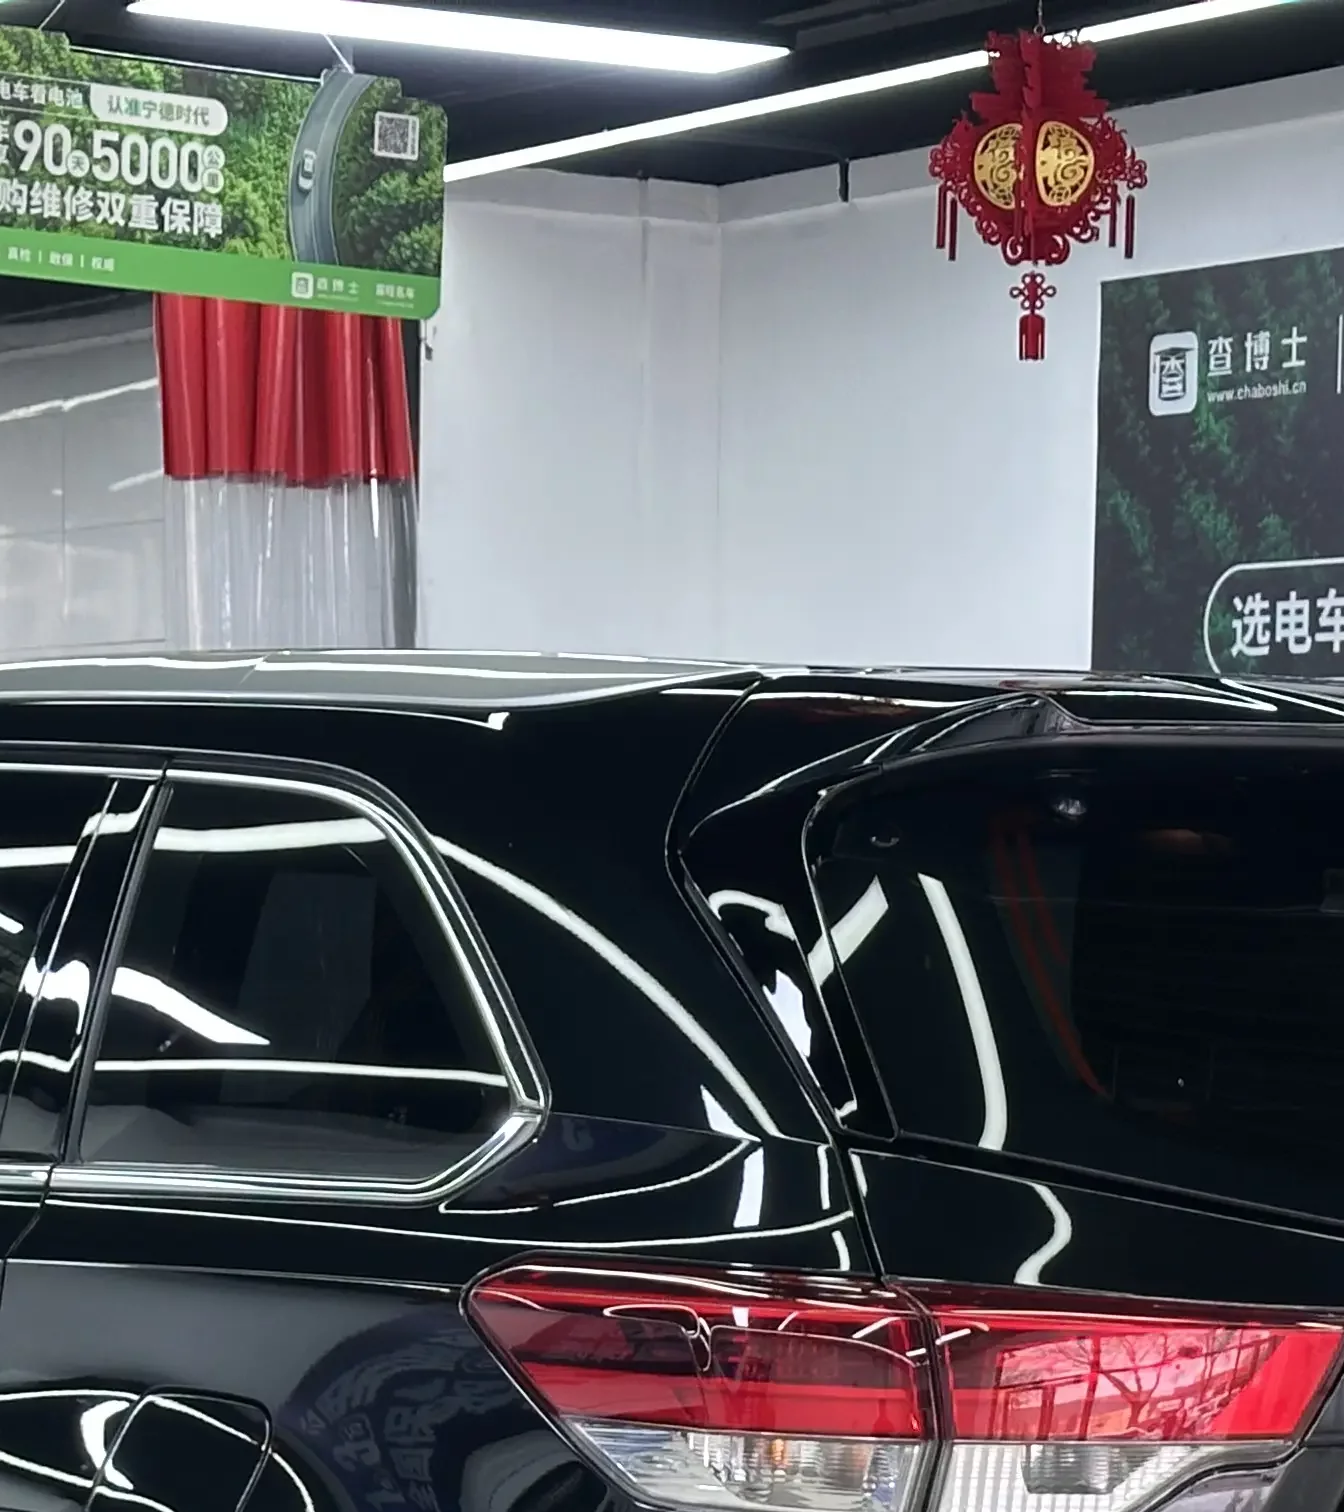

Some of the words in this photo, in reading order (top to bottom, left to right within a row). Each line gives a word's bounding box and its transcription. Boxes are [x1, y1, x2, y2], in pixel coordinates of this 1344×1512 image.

[107, 94, 210, 127] 认准宁德时代
[1207, 326, 1307, 377] 查博士
[1207, 380, 1307, 403] www.chaboshi.cn
